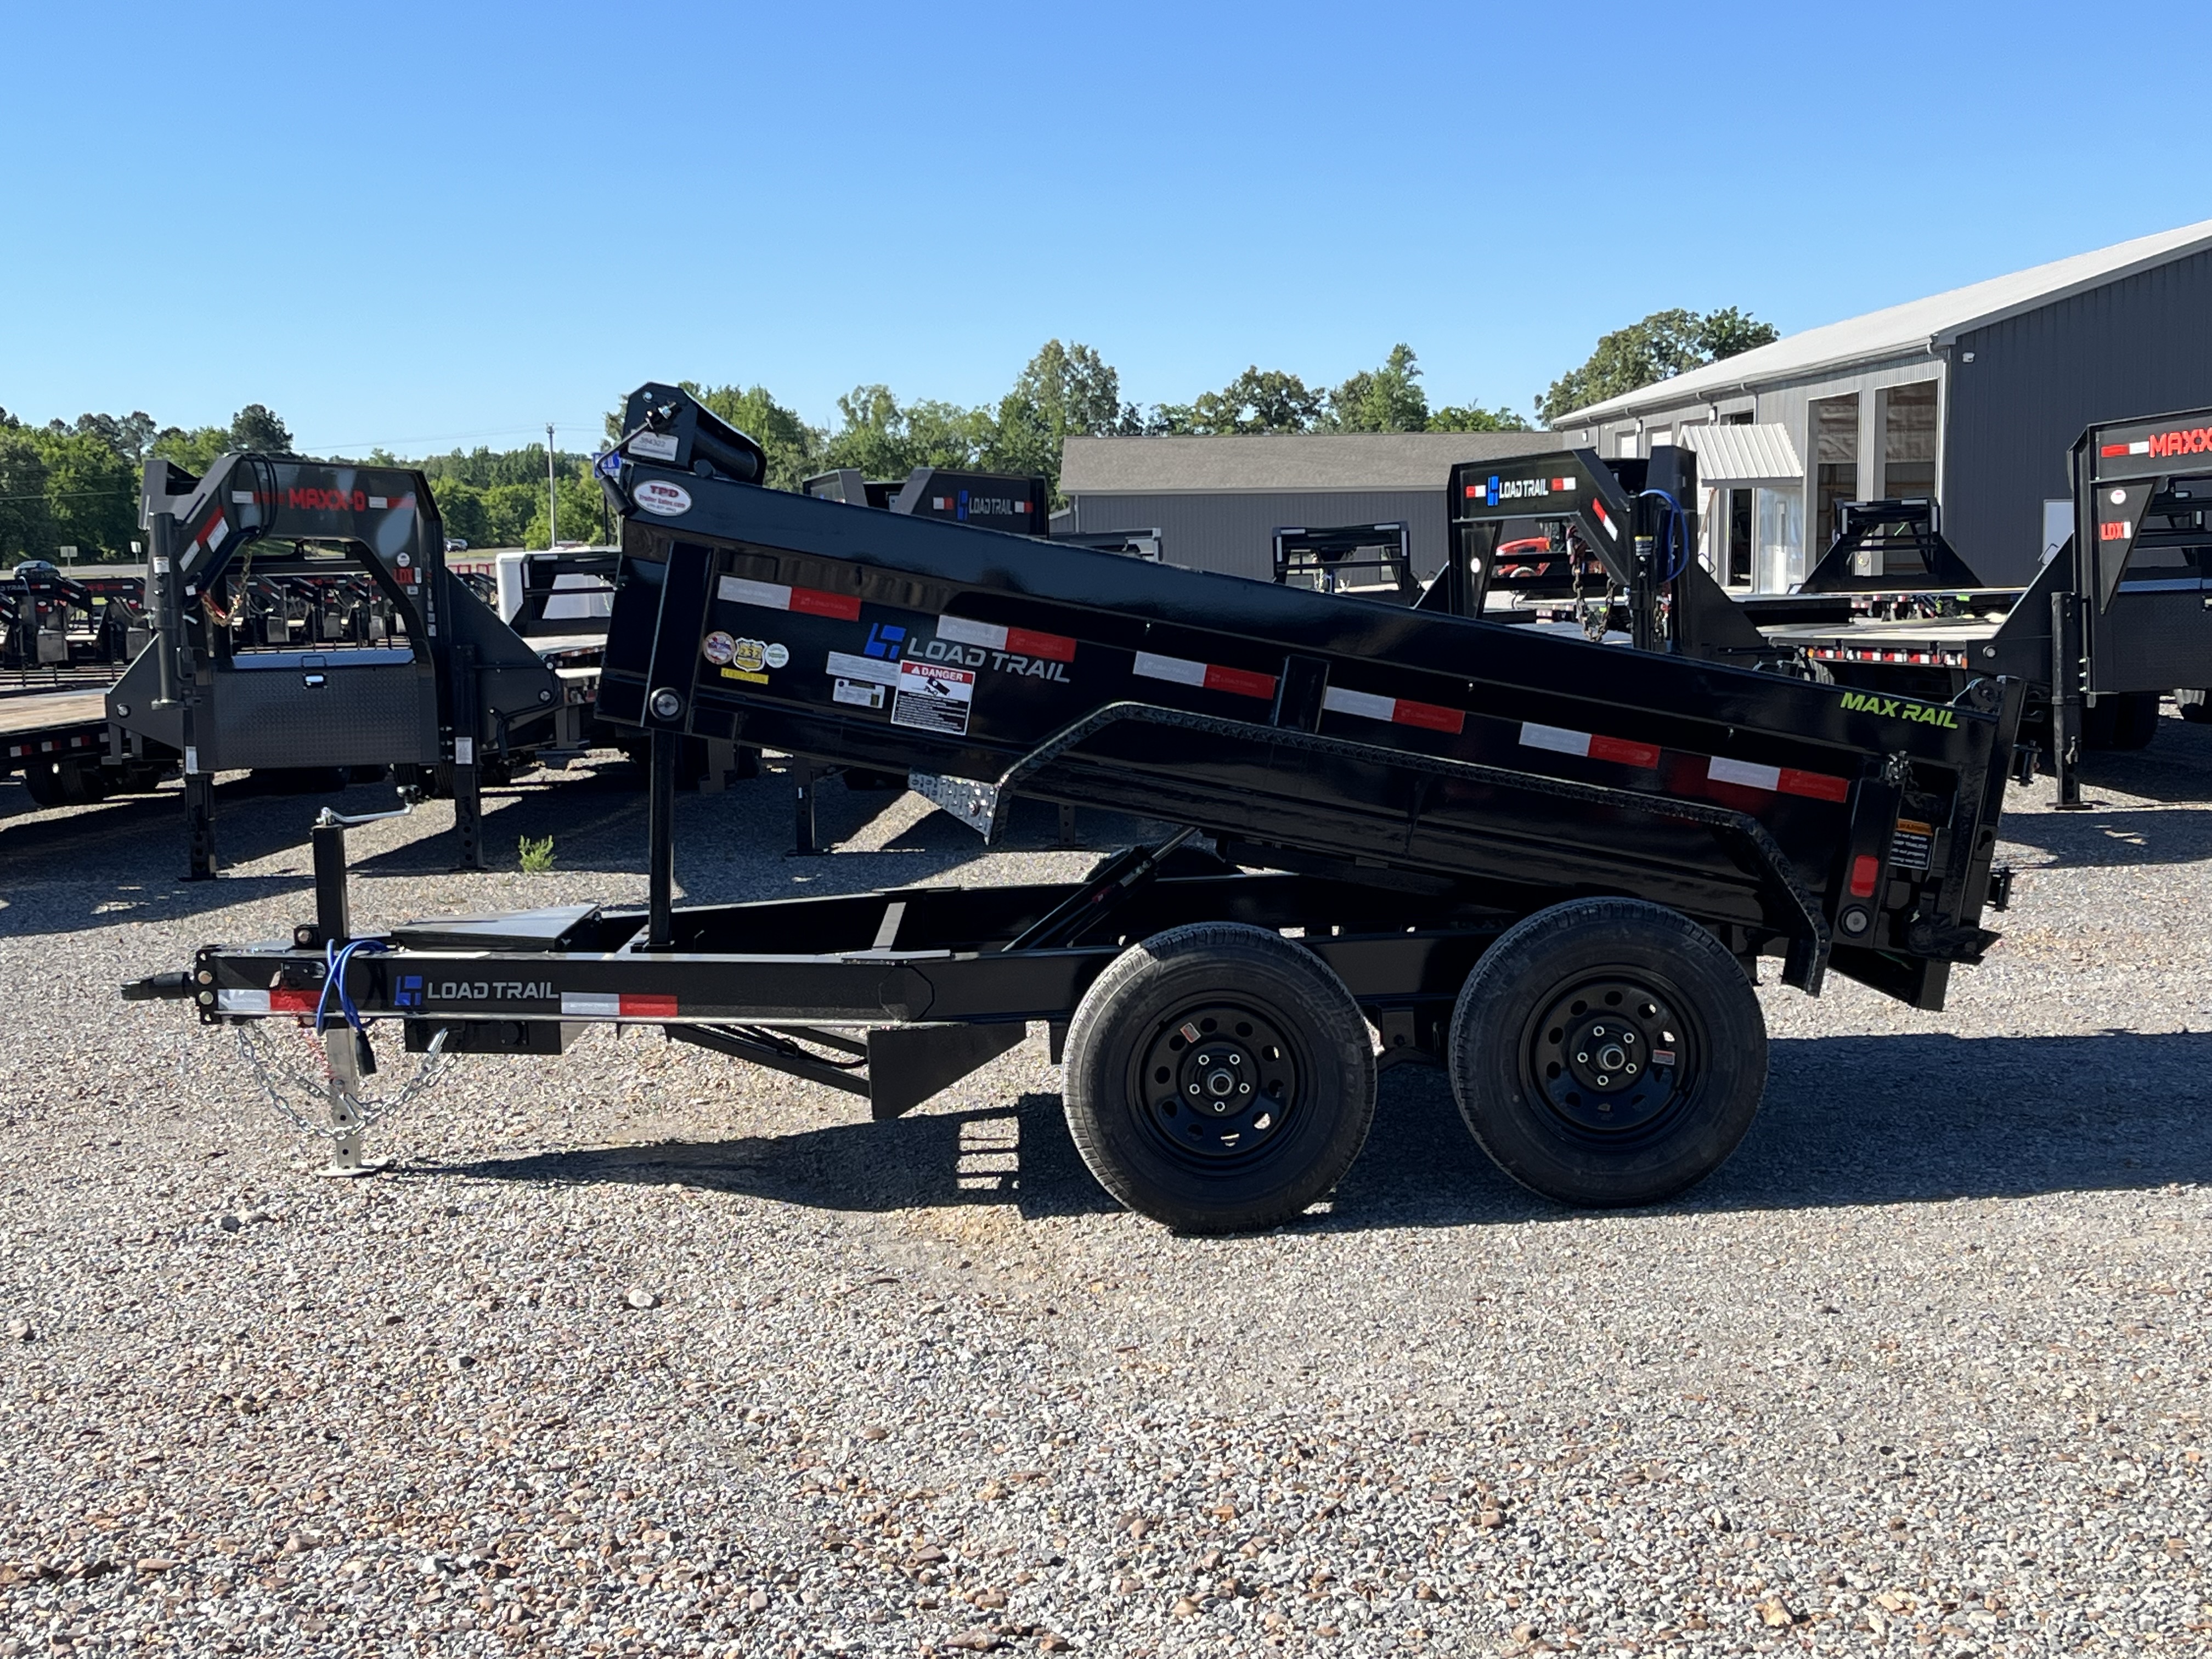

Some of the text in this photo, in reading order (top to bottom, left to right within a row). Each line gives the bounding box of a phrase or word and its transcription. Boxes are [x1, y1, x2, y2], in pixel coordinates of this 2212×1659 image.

[650, 485, 679, 498] TPD
[1499, 478, 1549, 499] LOAD TRAIL
[289, 487, 366, 512] MAXX-D
[969, 498, 1013, 515] LOAD TRAIL
[907, 637, 986, 667] LOAD
[991, 652, 1071, 684] TRAIL
[921, 667, 963, 681] DANGER
[1840, 692, 1958, 729] MAX RAIL
[427, 981, 559, 999] LOAD TRAIL
